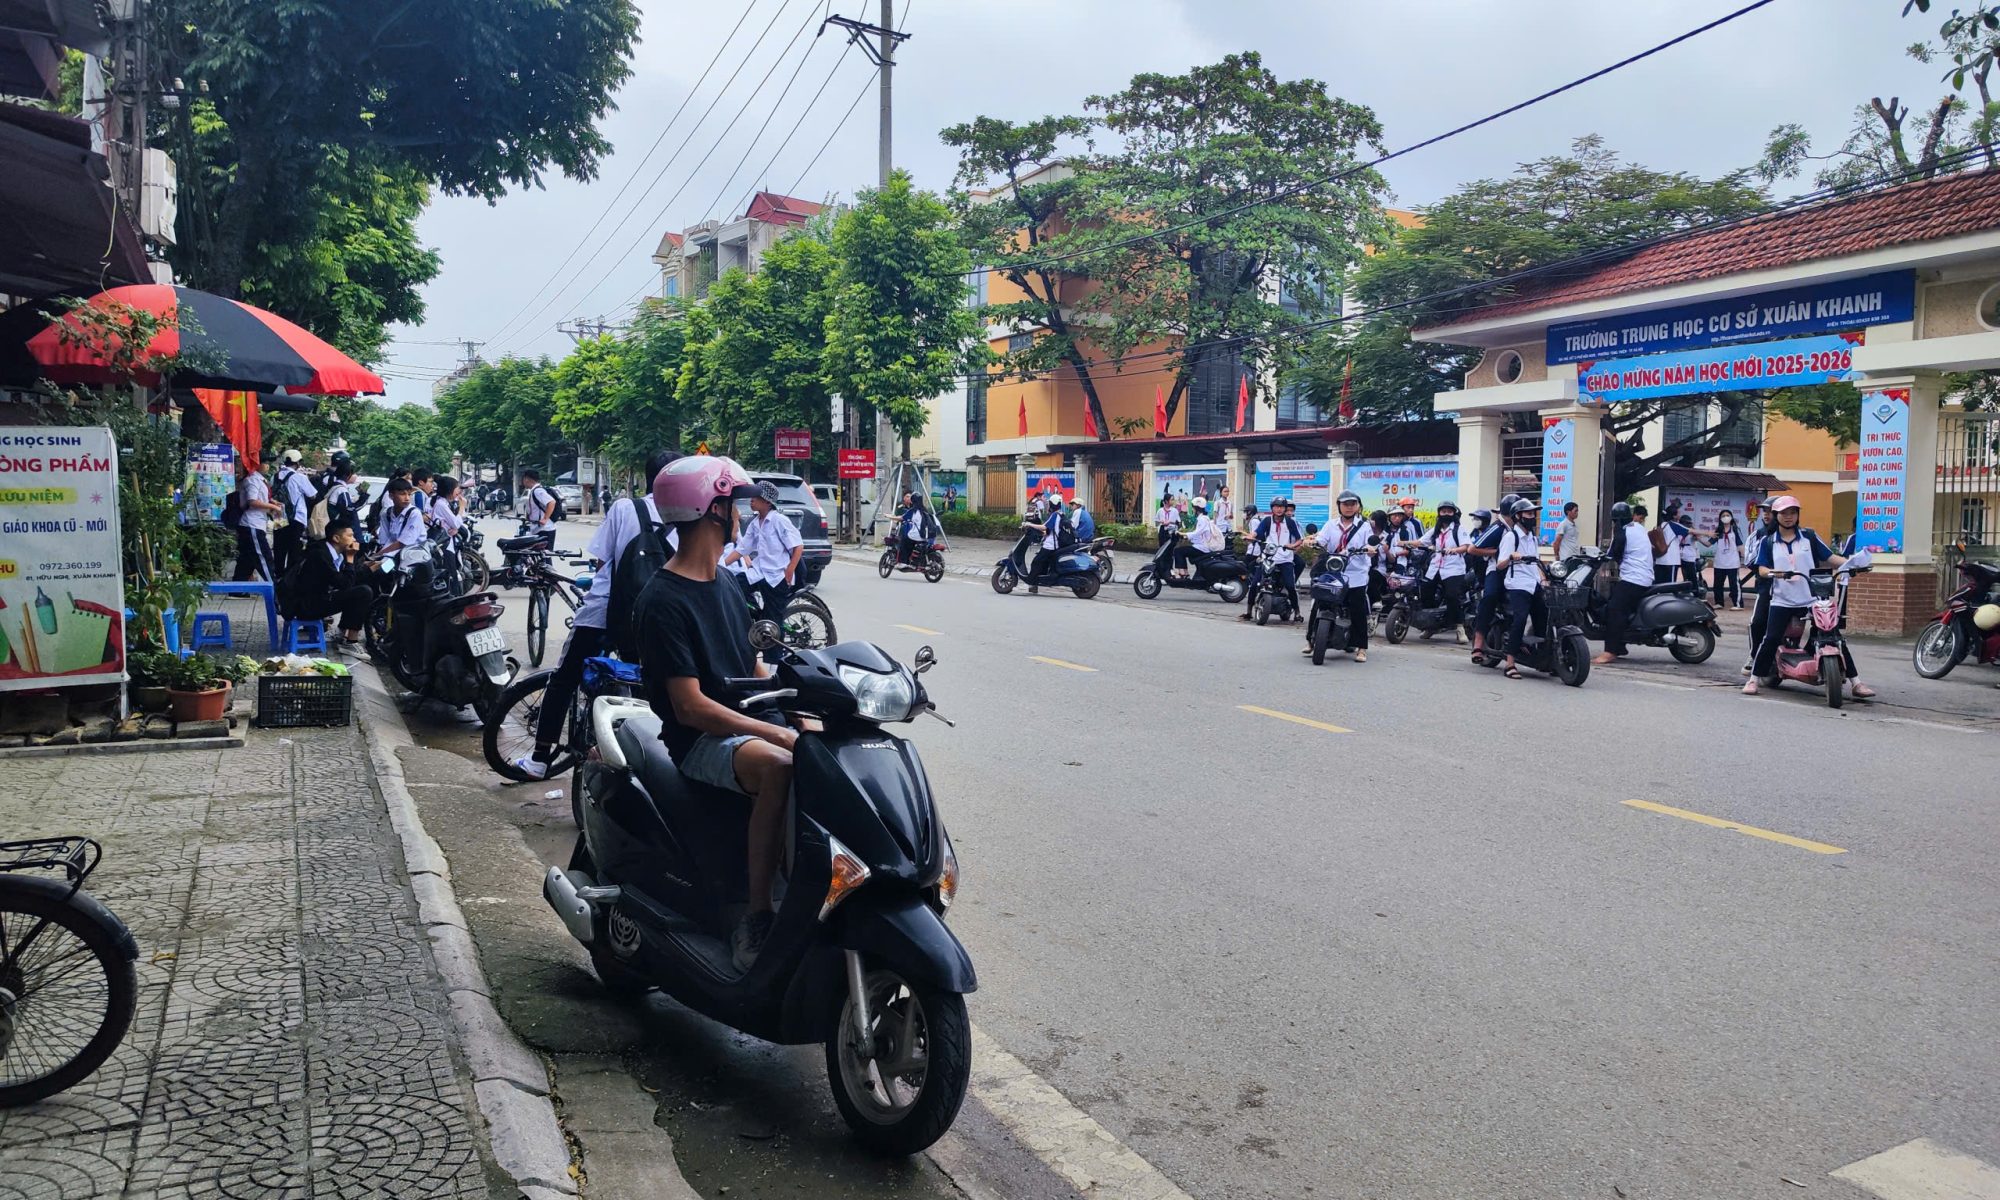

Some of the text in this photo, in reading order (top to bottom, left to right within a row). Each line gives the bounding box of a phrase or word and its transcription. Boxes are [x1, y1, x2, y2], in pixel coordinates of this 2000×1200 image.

[1565, 330, 1618, 352] TRƯỜNG
[1621, 322, 1669, 345] TRUNG
[1673, 318, 1704, 340] HỌC
[1709, 311, 1732, 333] CƠ
[1735, 303, 1759, 330] SỞ
[1763, 300, 1811, 326] XUÂN
[1816, 291, 1882, 319] KHANH
[1586, 349, 1852, 393] CHÀO MỪNG NĂM HỌC MỚI 2025-2026
[14, 436, 45, 449] HỌC
[47, 436, 81, 446] SINH
[49, 452, 111, 472] PHẨM
[29, 488, 64, 505] NIỆM
[1383, 484, 1399, 495] 20
[1407, 484, 1417, 494] 11
[1883, 506, 1899, 515] THU
[3, 518, 29, 534] GIÁO
[31, 521, 62, 533] KHOA
[63, 518, 77, 533] CŨ
[86, 518, 108, 532] MỚI
[39, 560, 103, 571] 0972.360.199
[861, 743, 899, 752] HONDA
